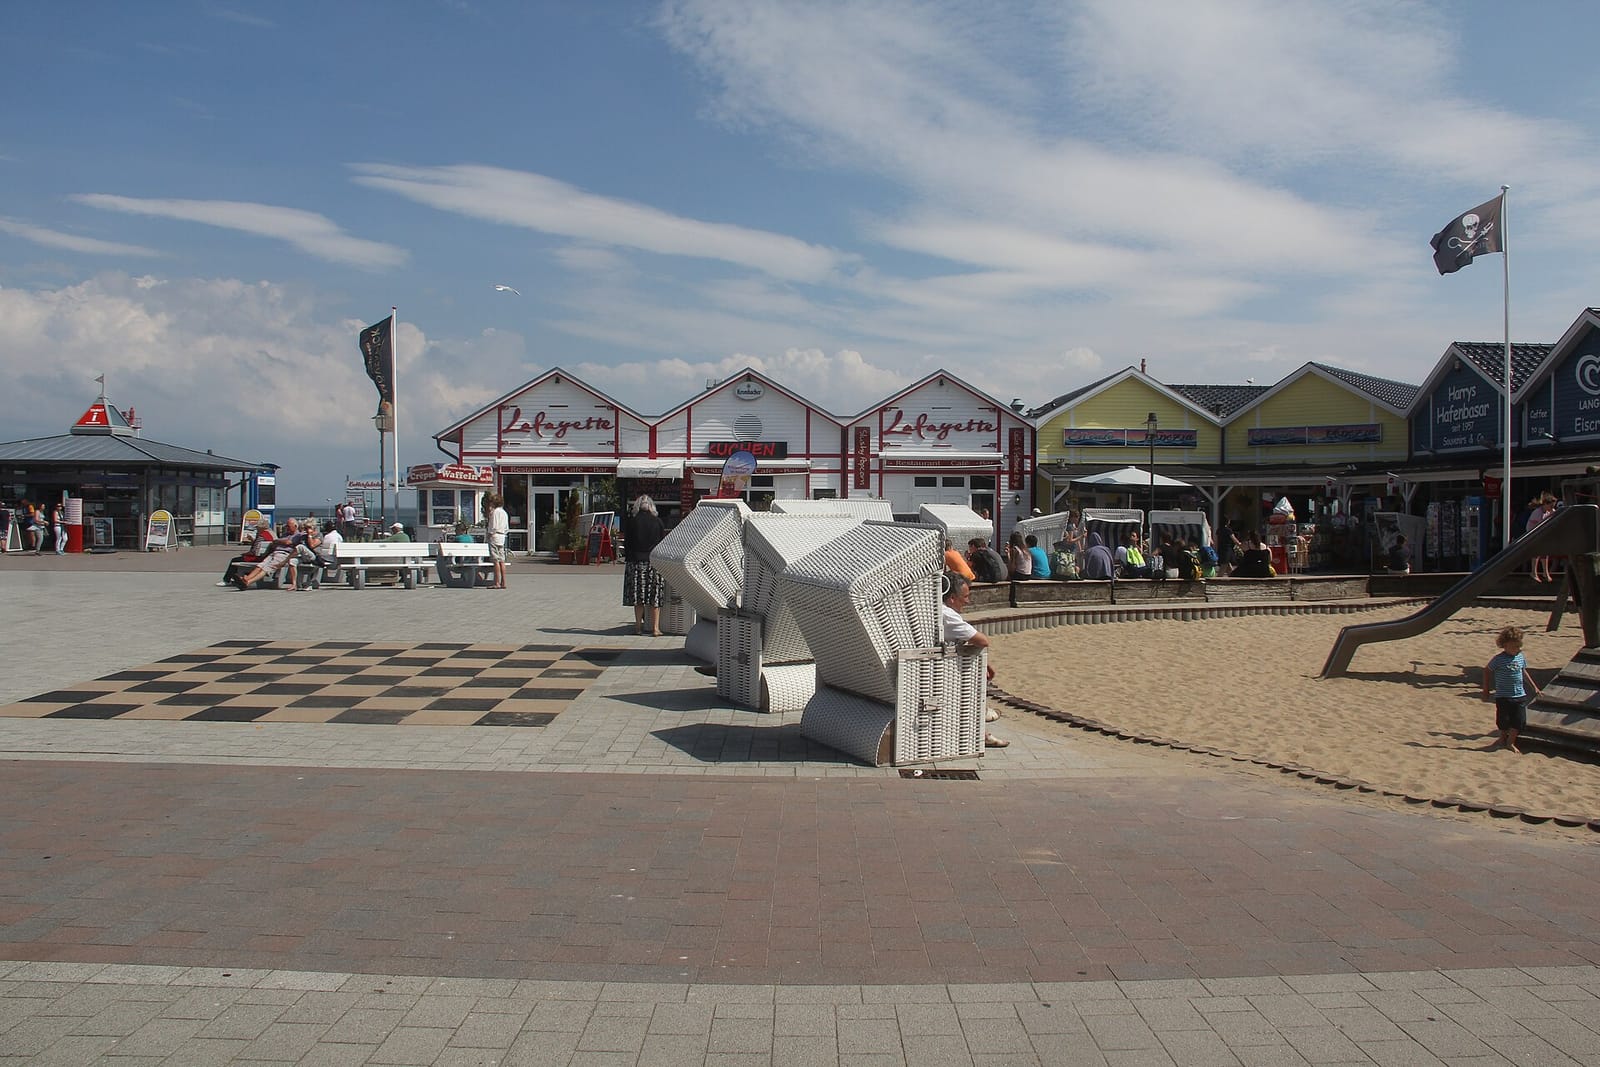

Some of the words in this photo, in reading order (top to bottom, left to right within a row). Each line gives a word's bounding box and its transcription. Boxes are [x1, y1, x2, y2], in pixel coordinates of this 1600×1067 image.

[1448, 385, 1477, 402] Harrys
[502, 407, 615, 438] Lafayette
[1436, 402, 1490, 424] Hafenbasar
[884, 410, 998, 440] Lafayette
[441, 470, 478, 481] Waffeln
